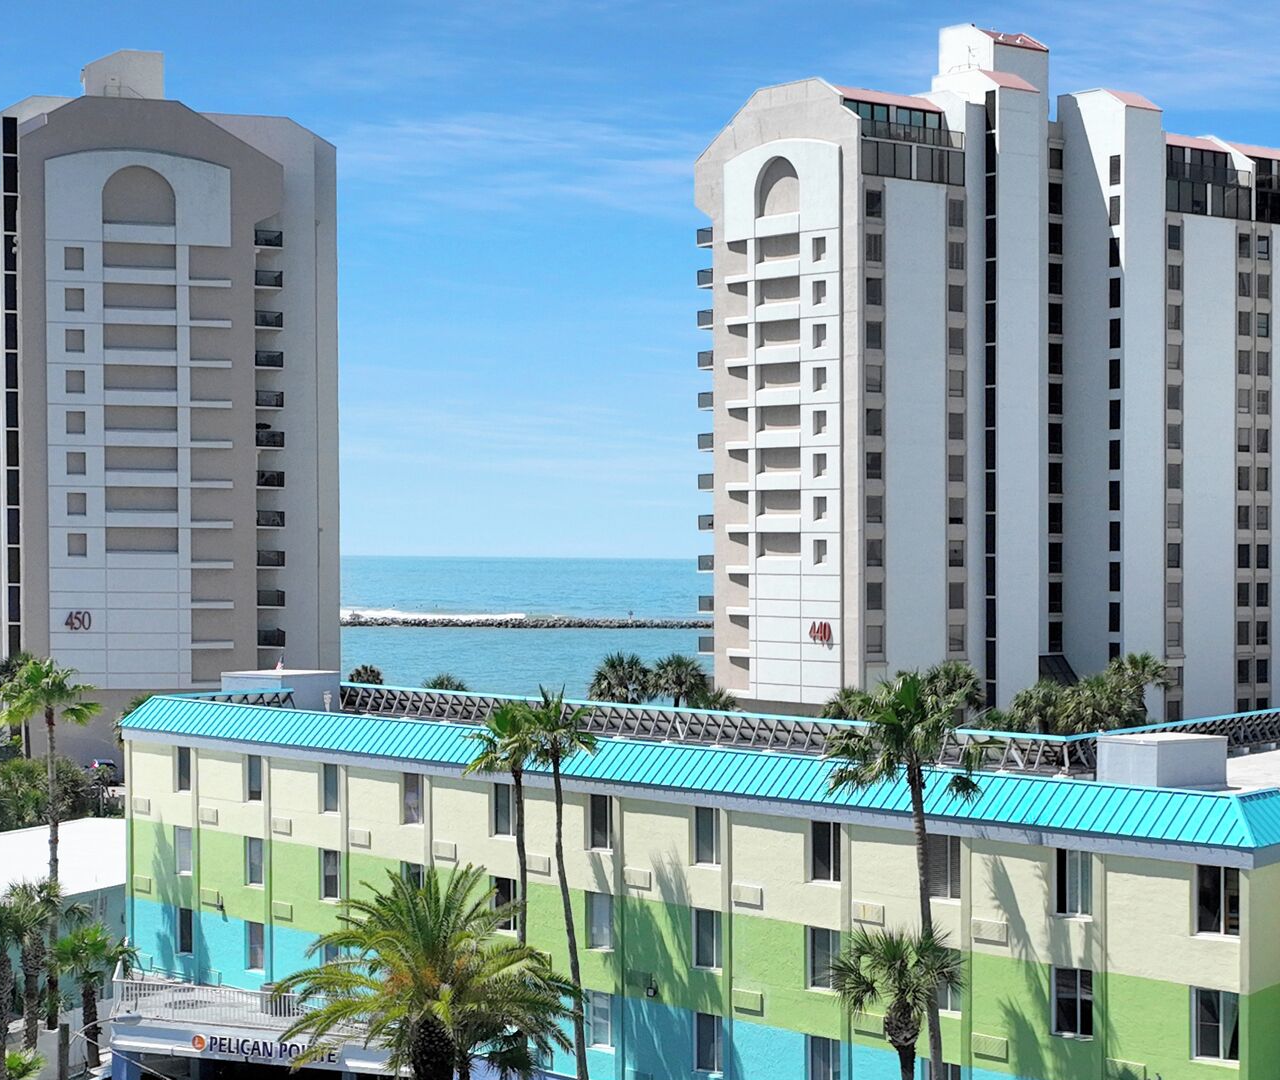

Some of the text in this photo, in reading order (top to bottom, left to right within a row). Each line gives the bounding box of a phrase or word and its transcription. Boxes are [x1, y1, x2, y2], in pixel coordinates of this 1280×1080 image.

[64, 611, 92, 631] 450
[809, 621, 832, 643] 440
[209, 1036, 273, 1058] PELICAN
